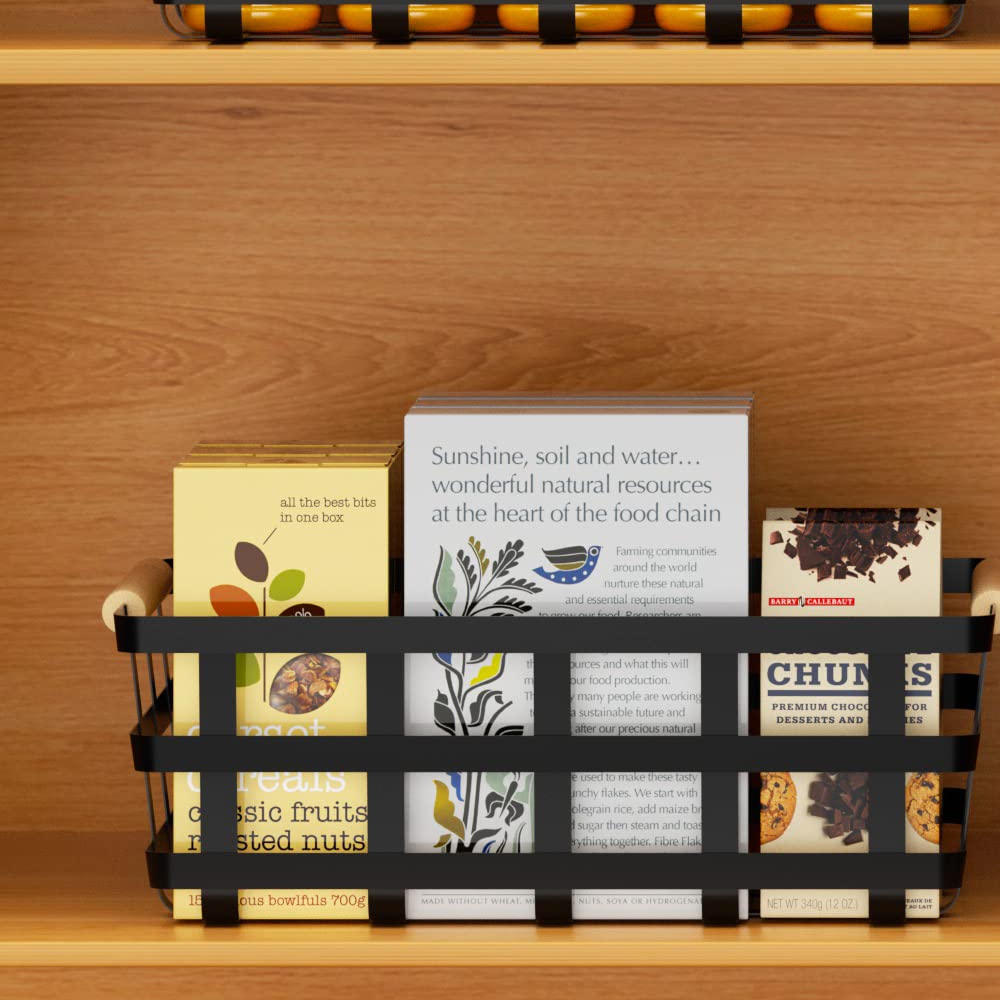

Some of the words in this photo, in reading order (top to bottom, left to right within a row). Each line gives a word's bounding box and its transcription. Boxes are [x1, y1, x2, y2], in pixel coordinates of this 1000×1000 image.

[431, 445, 530, 469] Sunshine,
[535, 445, 569, 465] soil
[576, 445, 615, 465] and
[431, 474, 534, 494] wonderful
[541, 474, 610, 494] natural
[618, 478, 712, 494] resources
[280, 497, 296, 508] all
[299, 497, 321, 508] the
[323, 497, 351, 508] best
[353, 497, 377, 508] bits
[280, 512, 293, 522] in
[296, 514, 319, 522] one
[322, 512, 344, 522] box
[431, 506, 450, 522] at
[456, 503, 487, 522] the
[494, 503, 544, 522] heart
[550, 502, 571, 522] of
[576, 503, 608, 522] the
[613, 502, 659, 522] food
[666, 503, 721, 522] chain
[616, 546, 652, 558] Farming
[656, 546, 717, 556] communities
[613, 563, 648, 572] around
[651, 562, 666, 572] the
[669, 562, 697, 572] world
[604, 579, 638, 588] nurture
[642, 578, 668, 588] these
[670, 578, 704, 588] natural
[565, 594, 584, 604] and
[586, 594, 628, 604] essential
[631, 594, 694, 606] requirements
[603, 659, 622, 668] and
[624, 659, 649, 668] what
[651, 659, 668, 668] this
[671, 659, 689, 668] will
[767, 663, 932, 686] CHUNS
[589, 675, 612, 685] food
[614, 675, 671, 688] production.
[577, 694, 605, 704] many
[607, 691, 641, 704] people
[579, 707, 633, 718] sustainable
[636, 707, 664, 718] future
[667, 707, 686, 718] and
[776, 716, 835, 724] DESSERTS
[838, 716, 864, 724] AND
[575, 723, 597, 734] after
[598, 726, 616, 734] our
[618, 724, 660, 736] precious
[662, 723, 696, 734] natural
[580, 773, 604, 782] used
[606, 774, 616, 782] to
[618, 773, 646, 782] make
[648, 773, 674, 782] these
[634, 788, 652, 798] We
[654, 789, 674, 798] start
[677, 788, 698, 798] with
[188, 802, 282, 822] cssic
[290, 802, 368, 822] fruits
[638, 804, 656, 814] add
[658, 805, 689, 814] maize
[578, 822, 604, 832] sugar
[606, 820, 628, 830] then
[630, 822, 660, 830] steam
[662, 820, 681, 830] and
[188, 830, 293, 850] rsted
[302, 831, 366, 851] nuts
[268, 894, 327, 906] bowlfuls
[332, 895, 366, 908] 700g
[768, 899, 782, 908] NET
[785, 899, 798, 908] WT
[801, 899, 822, 911] 340g
